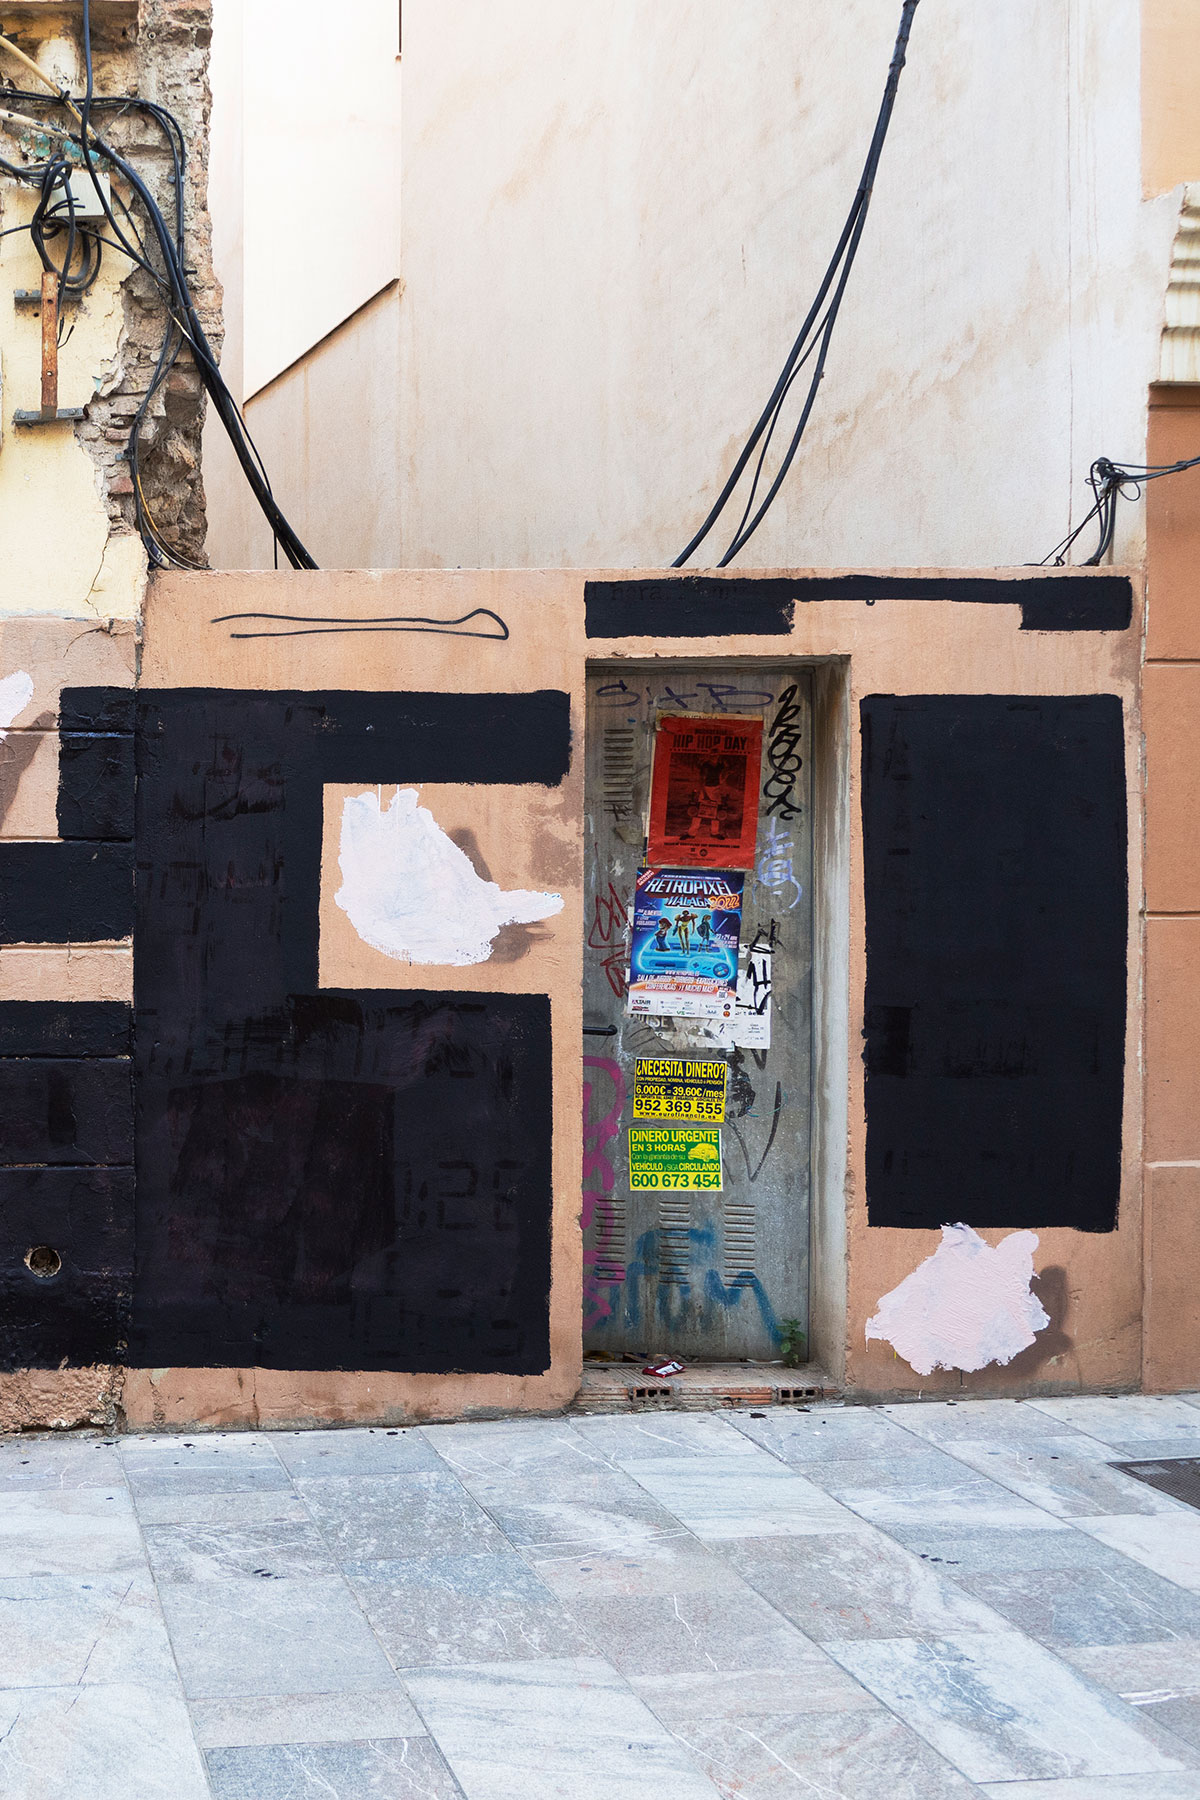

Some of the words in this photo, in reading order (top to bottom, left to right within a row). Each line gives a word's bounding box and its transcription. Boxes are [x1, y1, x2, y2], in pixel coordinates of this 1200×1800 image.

[672, 734, 694, 748] HIP
[696, 735, 721, 749] HOP
[724, 736, 749, 750] DAY
[645, 878, 732, 896] RETROPIXEL
[709, 893, 740, 911] 2022
[636, 1059, 684, 1077] ¿NECESITA
[685, 1061, 725, 1079] DINERO?
[636, 1085, 667, 1095] 6.000€
[635, 1099, 661, 1112] 952
[665, 1100, 692, 1113] 369
[696, 1102, 722, 1115] 555
[631, 1130, 670, 1143] DINERO
[671, 1130, 719, 1143] URGENTE
[632, 1144, 644, 1152] EN
[646, 1144, 653, 1152] 3
[654, 1143, 687, 1152] HORAS
[678, 1162, 720, 1171] CIRCULANDO
[631, 1173, 659, 1188] 600
[662, 1173, 690, 1188] 673
[692, 1174, 721, 1188] 454
